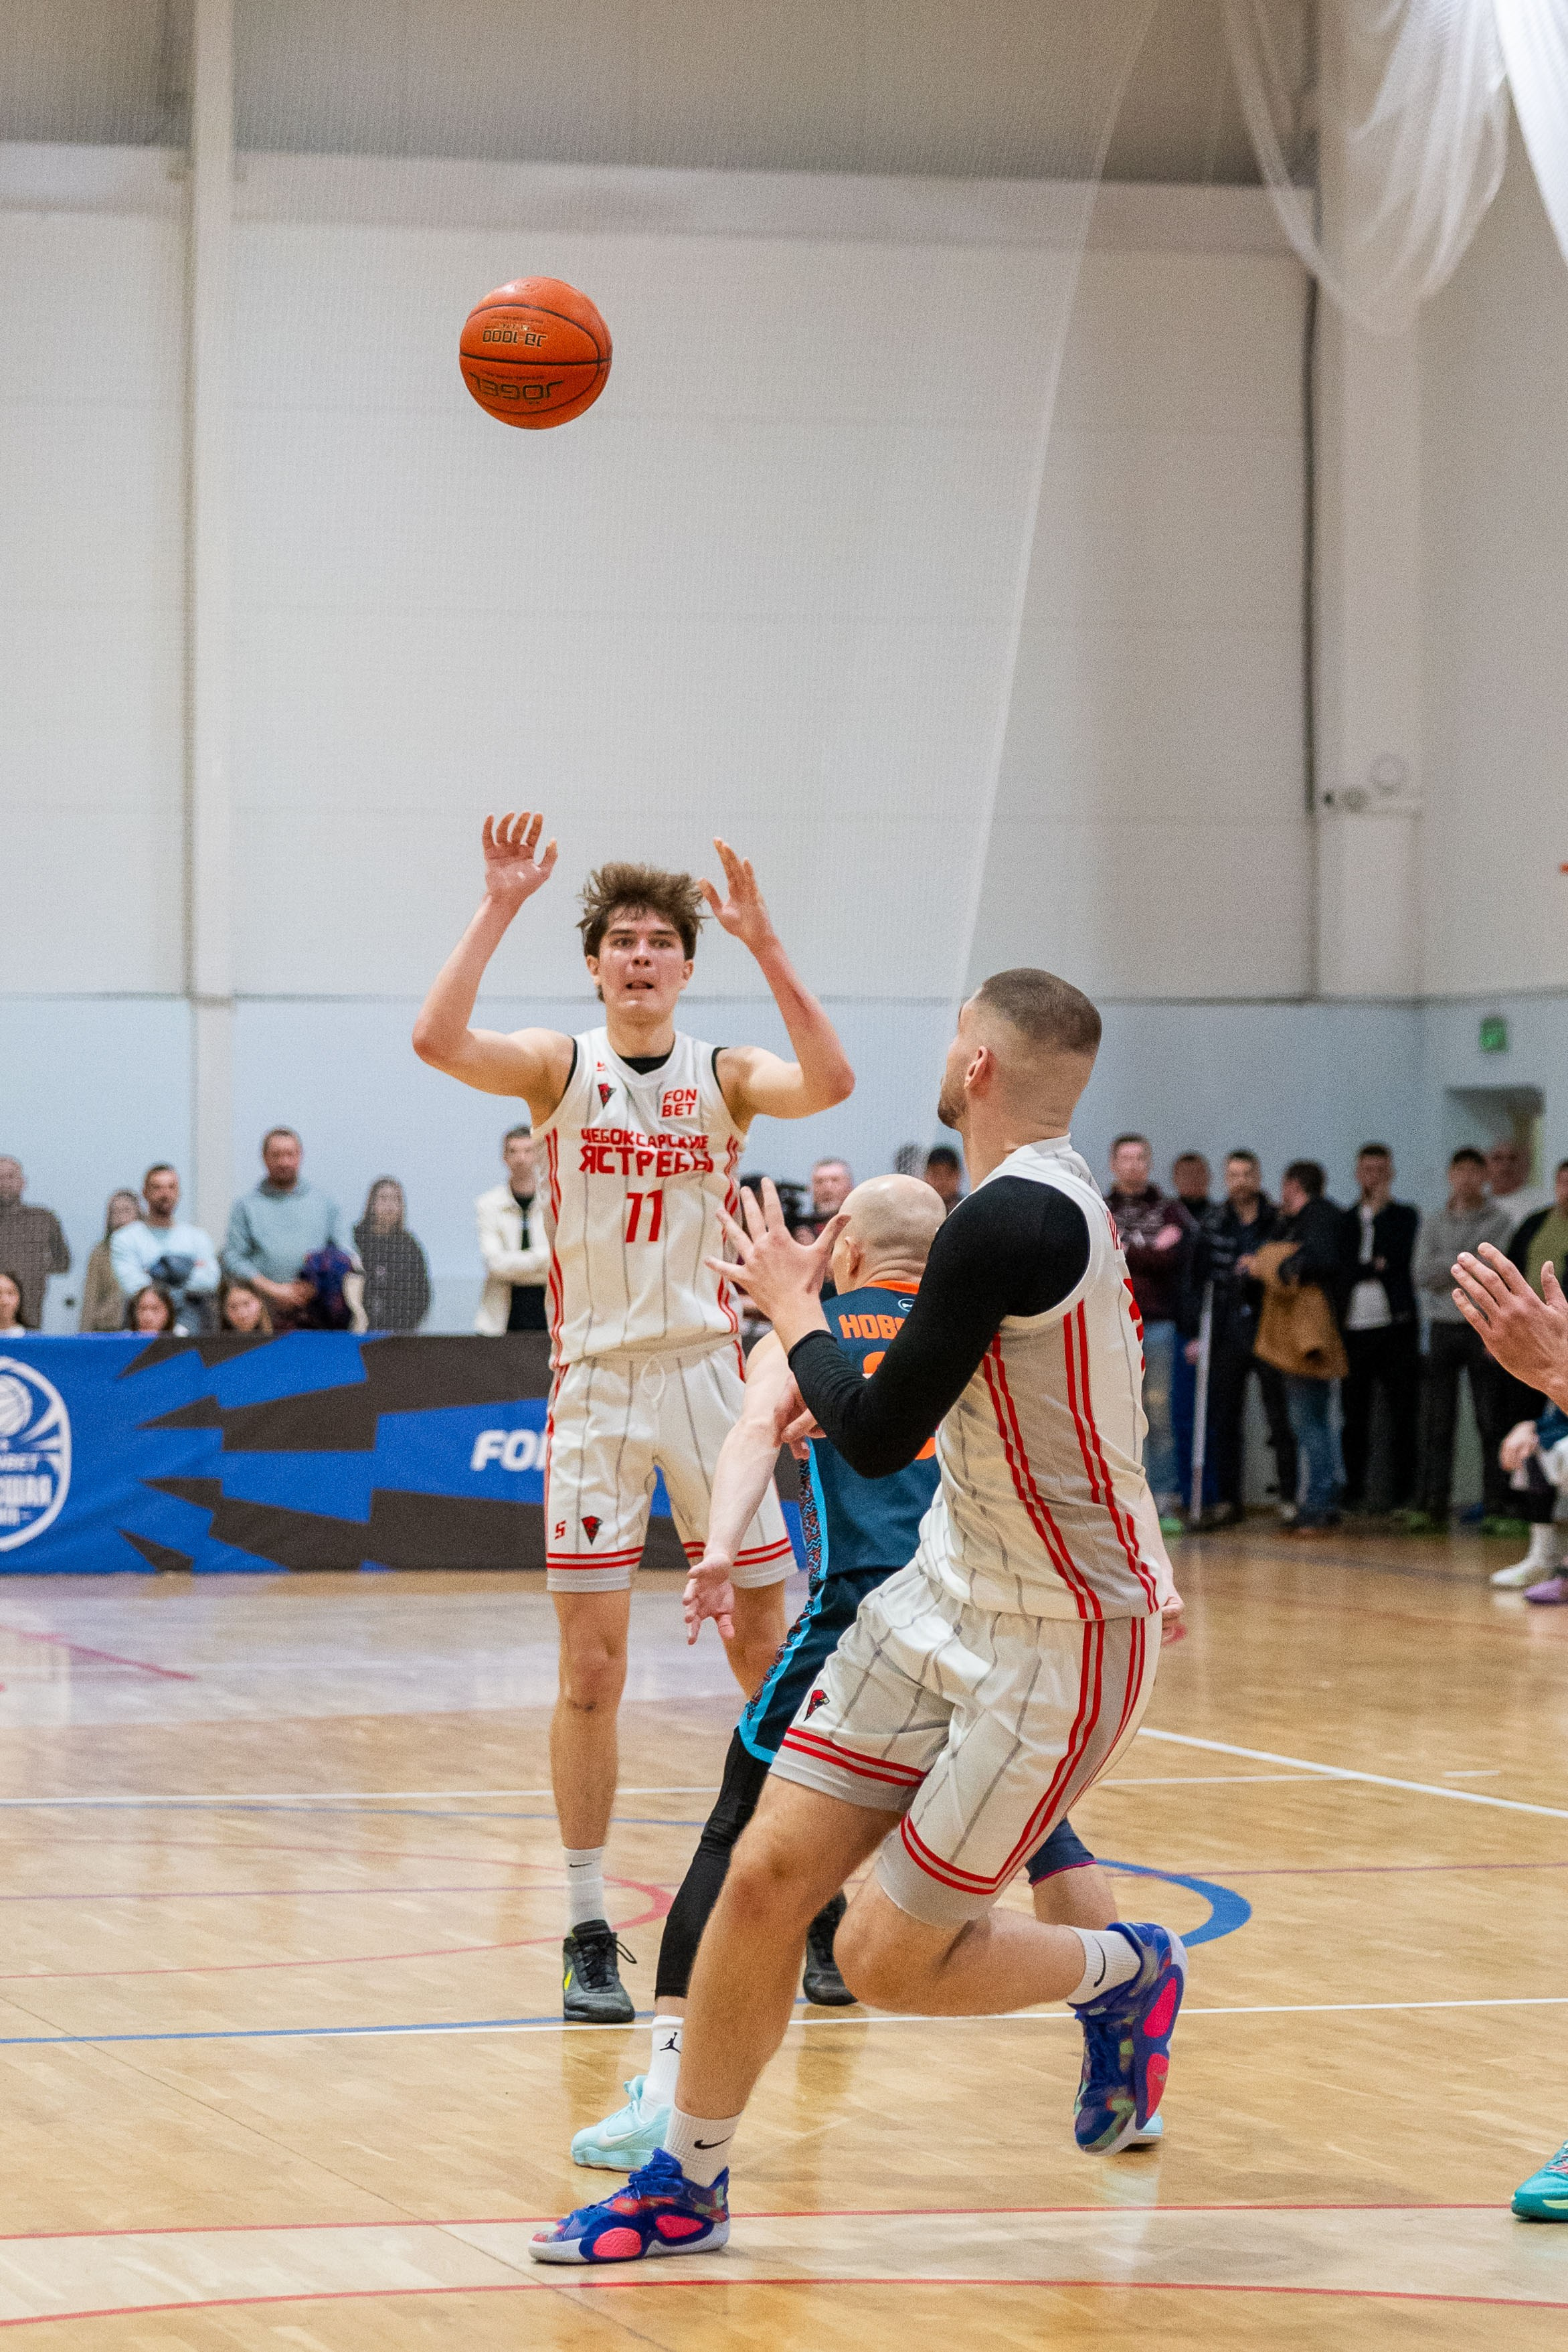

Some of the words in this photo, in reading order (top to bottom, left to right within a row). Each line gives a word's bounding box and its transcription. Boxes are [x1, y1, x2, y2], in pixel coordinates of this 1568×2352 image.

[663, 1088, 697, 1104] FON
[661, 1103, 695, 1118] BET
[581, 1128, 709, 1149] ЧЕБОКСАРСКИЕ
[579, 1145, 714, 1177] ЯСТРЕБЫ
[625, 1189, 663, 1243] 11
